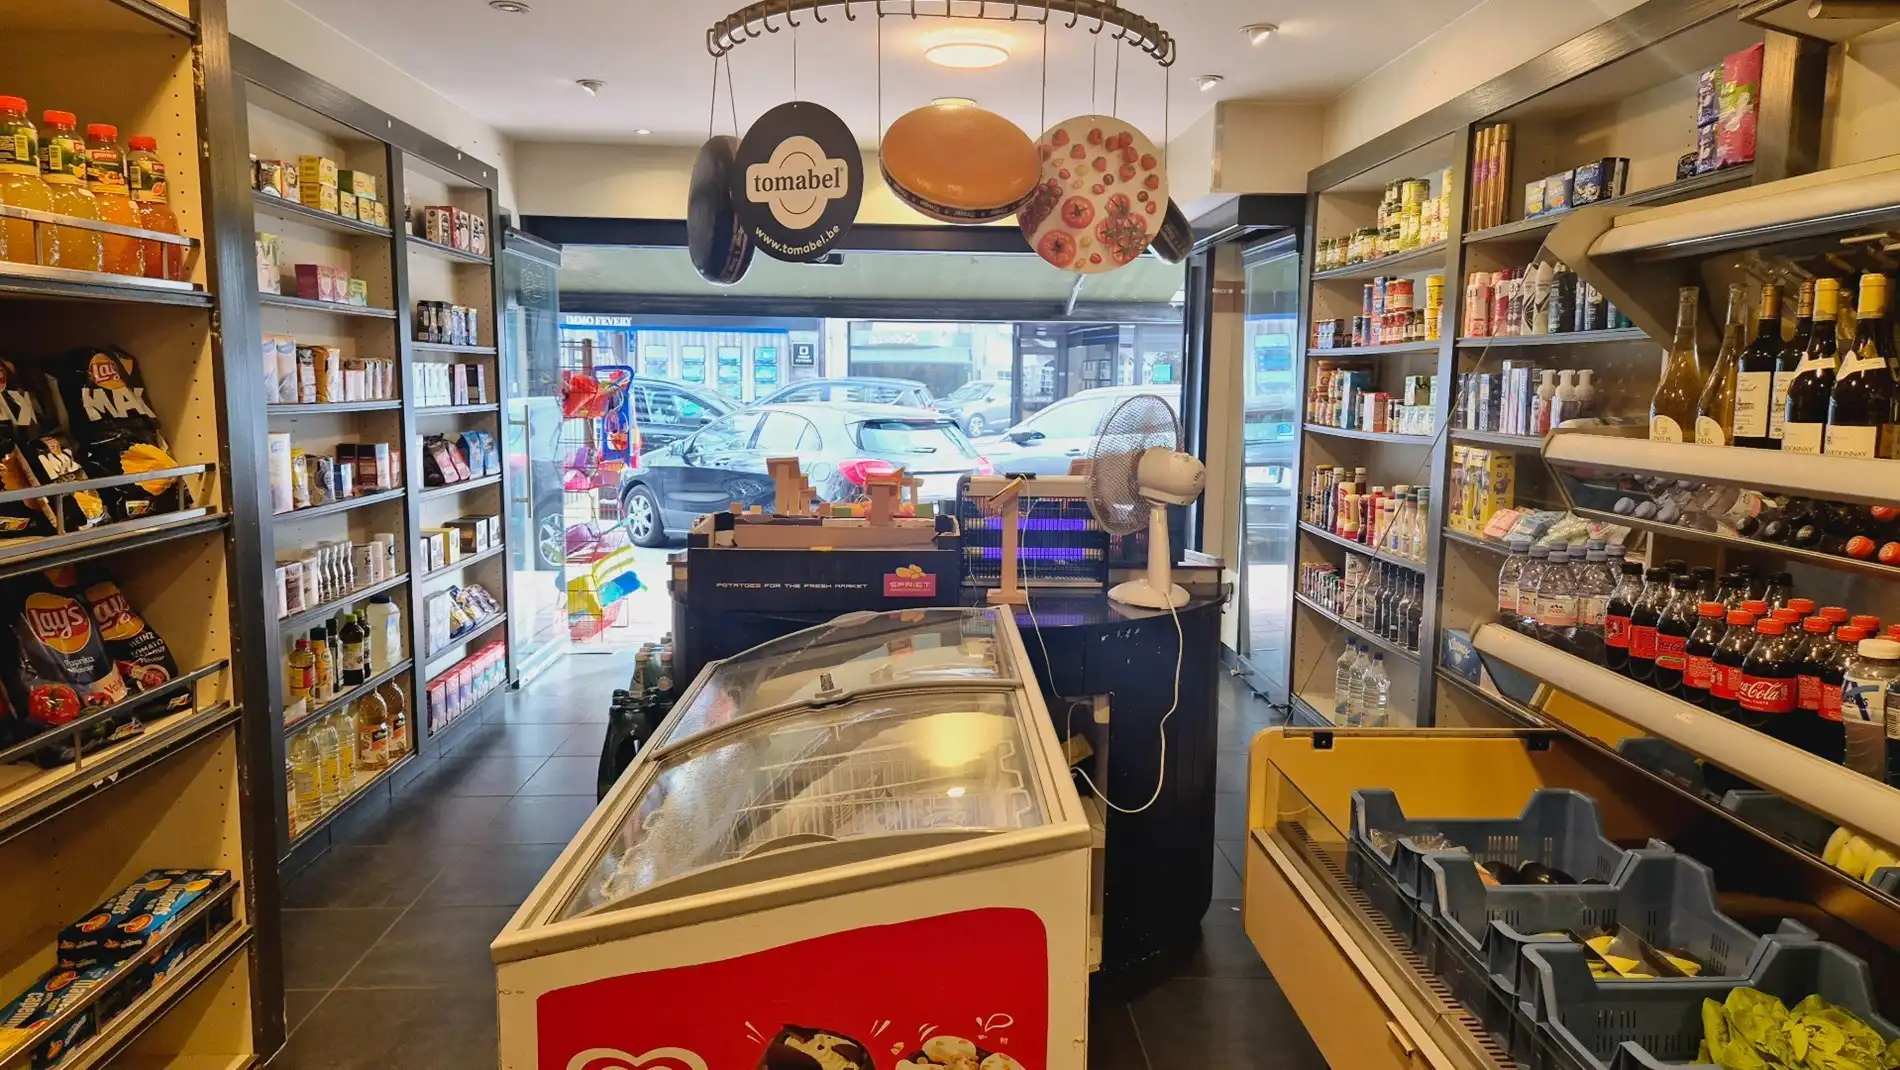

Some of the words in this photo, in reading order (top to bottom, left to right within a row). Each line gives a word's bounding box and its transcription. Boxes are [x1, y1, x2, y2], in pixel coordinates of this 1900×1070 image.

[753, 167, 841, 192] tomabel
[755, 224, 840, 256] www.tomabel.be
[31, 604, 85, 640] Lay's
